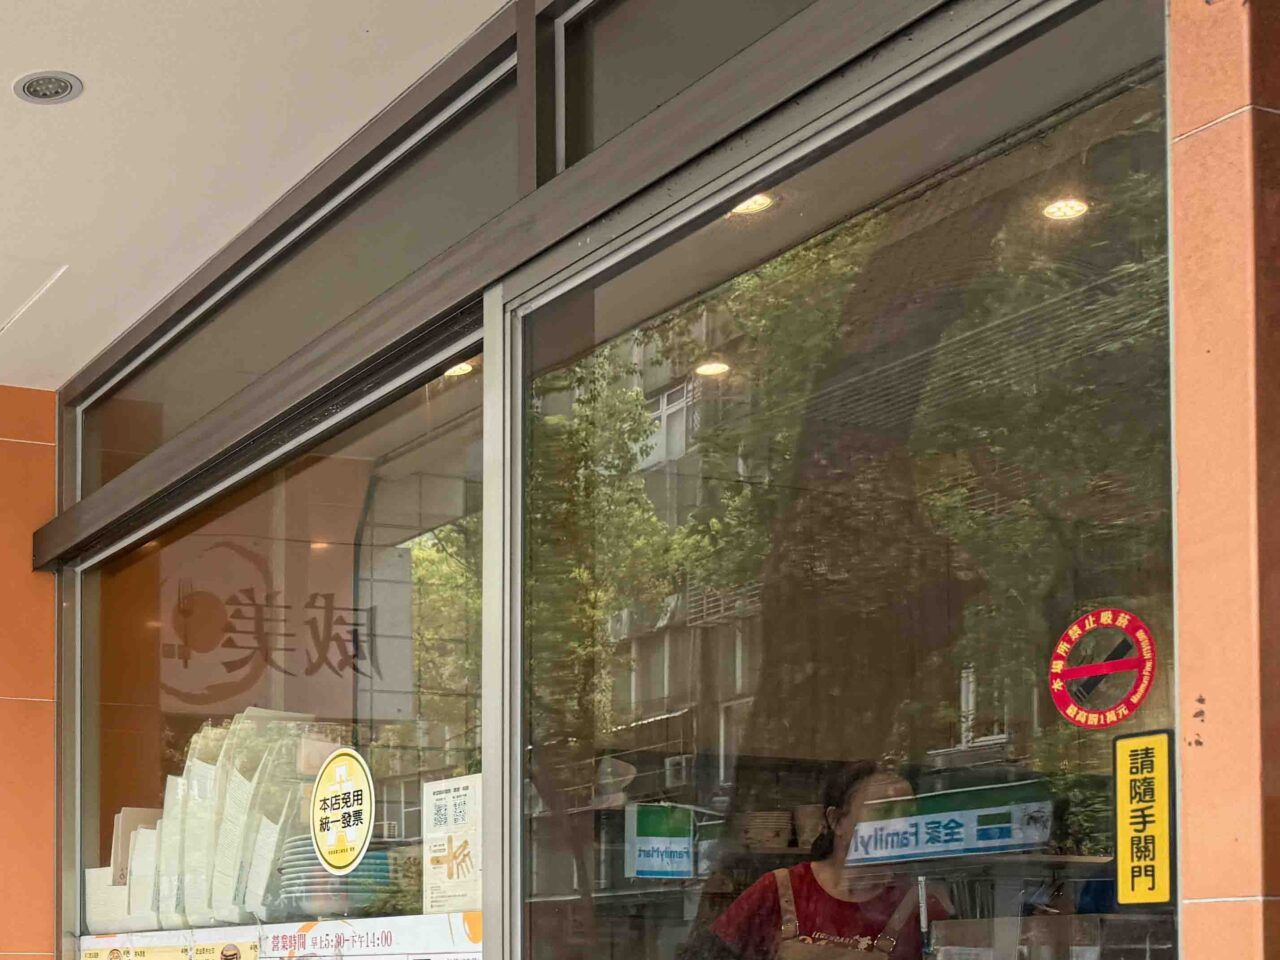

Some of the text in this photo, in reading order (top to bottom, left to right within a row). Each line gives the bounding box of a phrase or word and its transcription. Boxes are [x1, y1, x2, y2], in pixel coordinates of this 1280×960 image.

[319, 788, 363, 813] 本店免用
[319, 809, 363, 833] 統一發票
[1129, 747, 1156, 892] 請隨手關門
[271, 932, 307, 951] 營業時間
